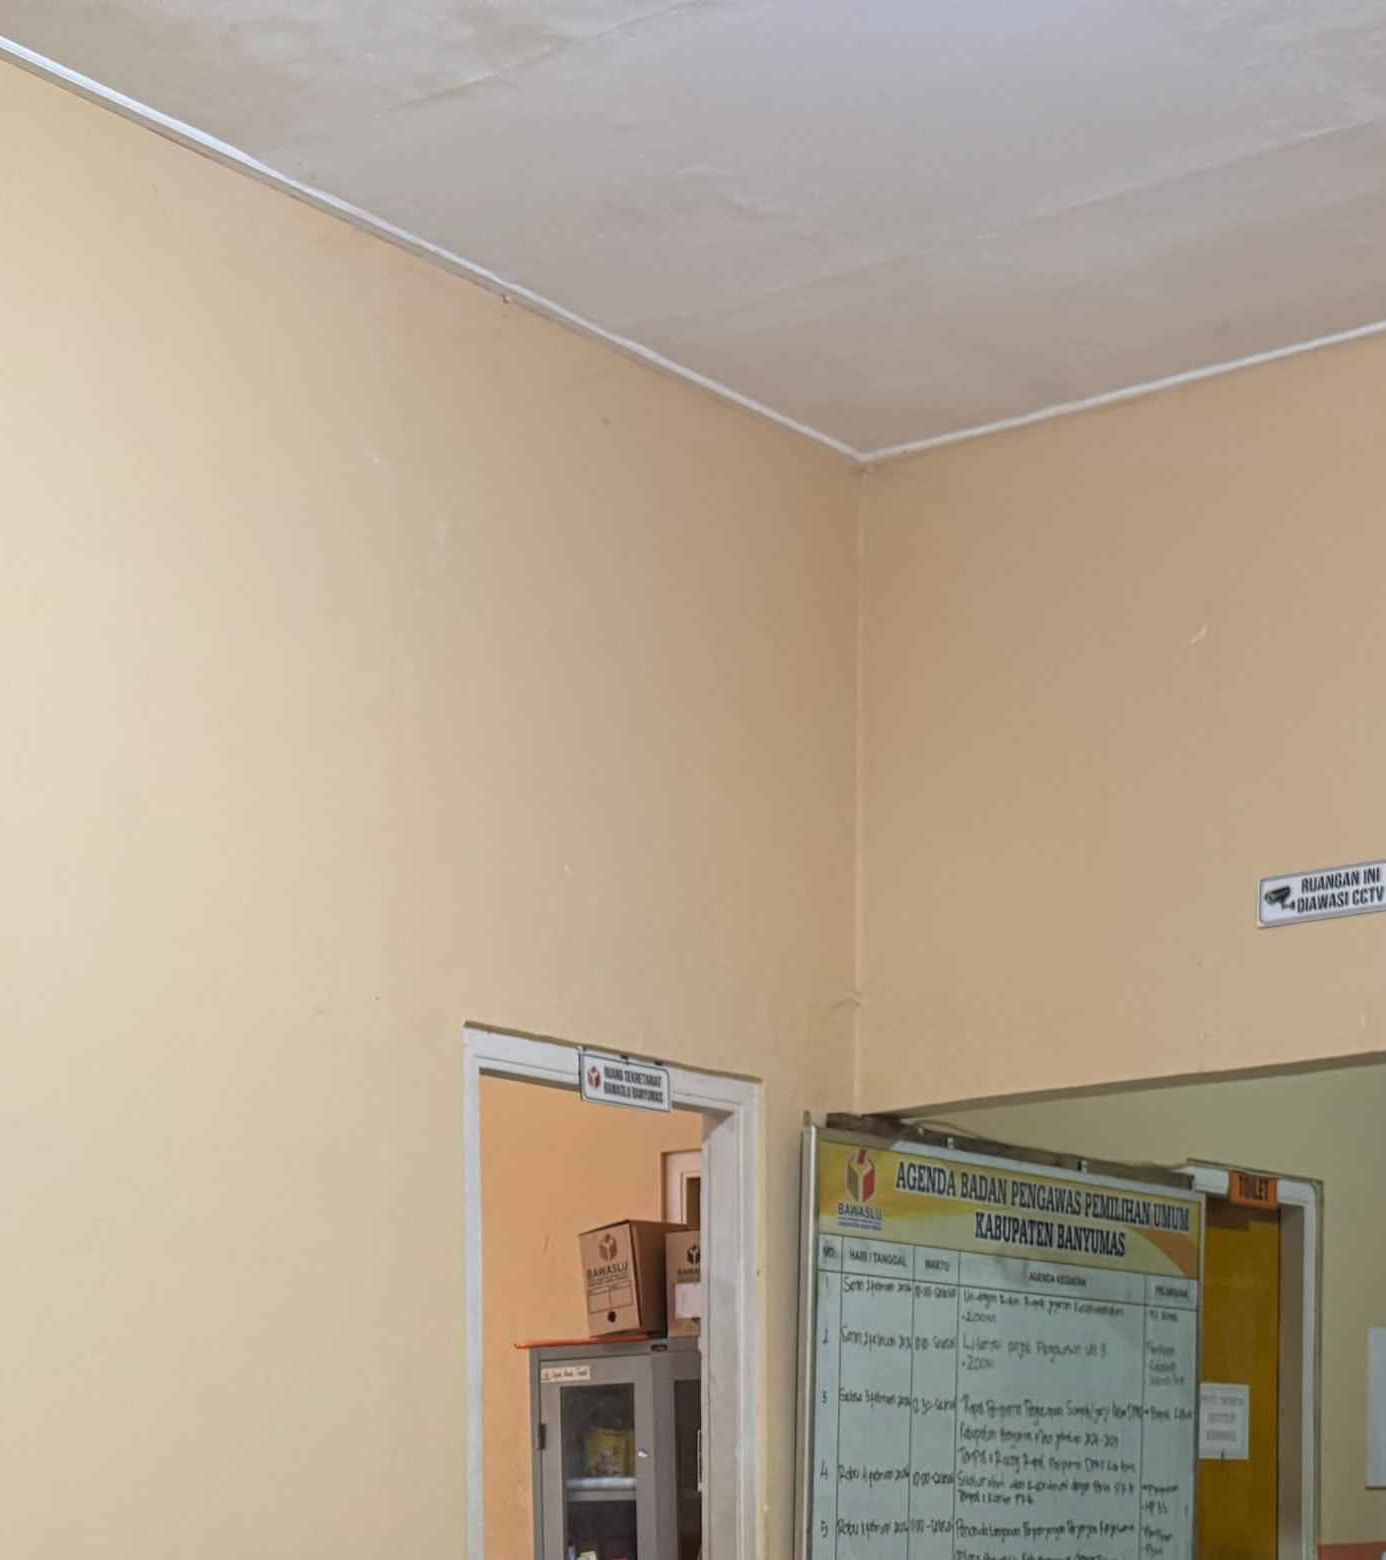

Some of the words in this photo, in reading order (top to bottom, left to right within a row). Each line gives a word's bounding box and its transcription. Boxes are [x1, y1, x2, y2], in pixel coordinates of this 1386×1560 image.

[1301, 871, 1360, 893] RUANGAN
[1363, 867, 1381, 884] INI
[1297, 891, 1349, 913] DIAWASI
[1352, 886, 1386, 906] CCTV
[896, 1161, 956, 1197] AGENDA
[961, 1172, 1007, 1205] BADAN
[1011, 1179, 1082, 1216] PENGAWAS
[1084, 1191, 1150, 1226] PEMILIHAN
[1154, 1203, 1190, 1232] UMUM
[837, 1203, 883, 1221] BAWASLU
[975, 1212, 1054, 1248] KABUPATEN
[1057, 1225, 1126, 1257] BANYUMAS
[587, 1262, 629, 1279] BAWASLU
